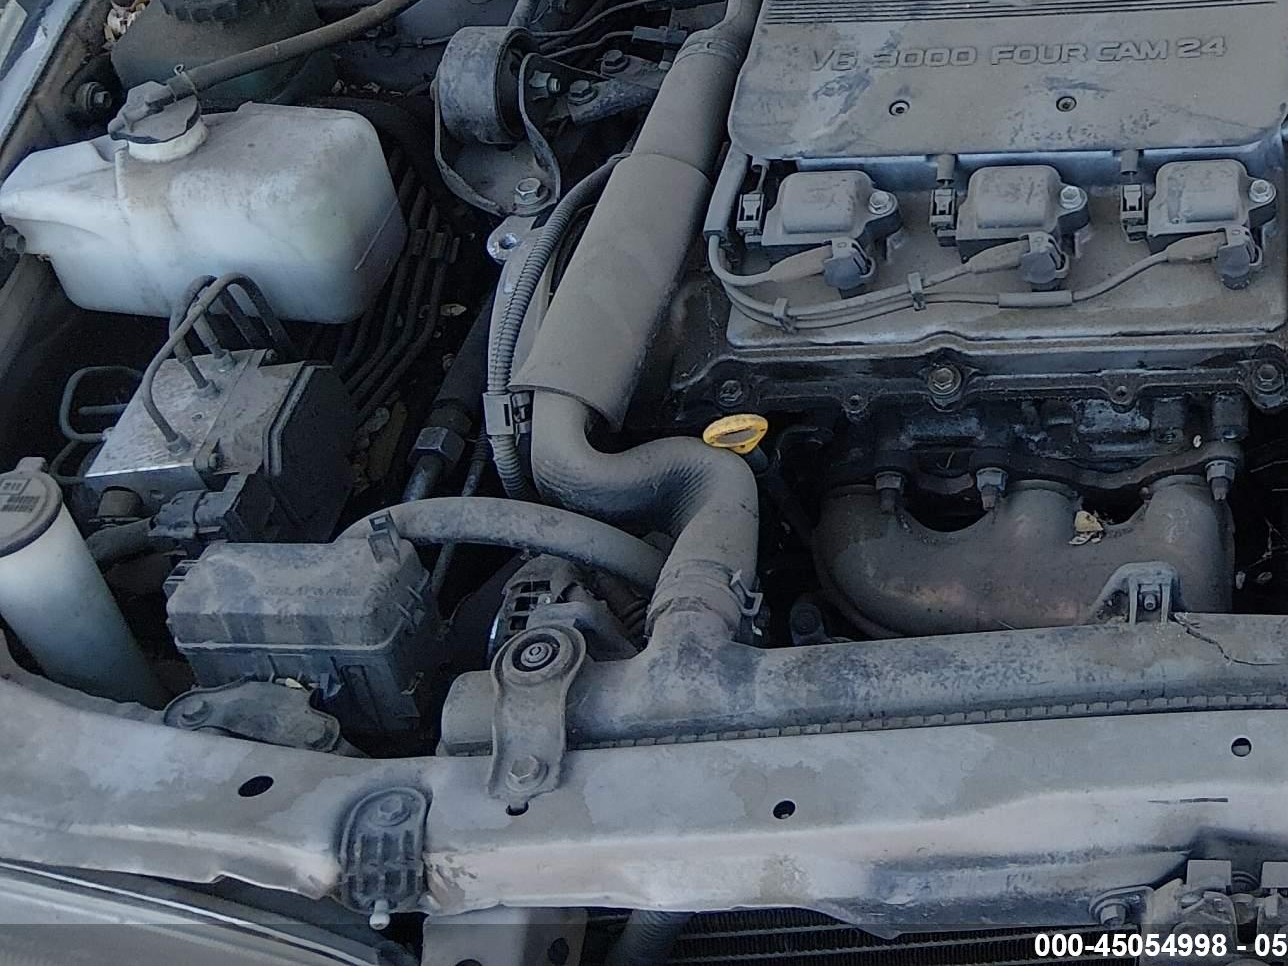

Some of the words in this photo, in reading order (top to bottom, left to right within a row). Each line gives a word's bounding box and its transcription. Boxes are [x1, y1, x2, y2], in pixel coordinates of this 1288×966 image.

[811, 49, 859, 71] V6
[872, 45, 977, 69] 3000
[991, 42, 1088, 65] FOUR
[1095, 40, 1168, 62] CAM
[1176, 37, 1227, 58] 24
